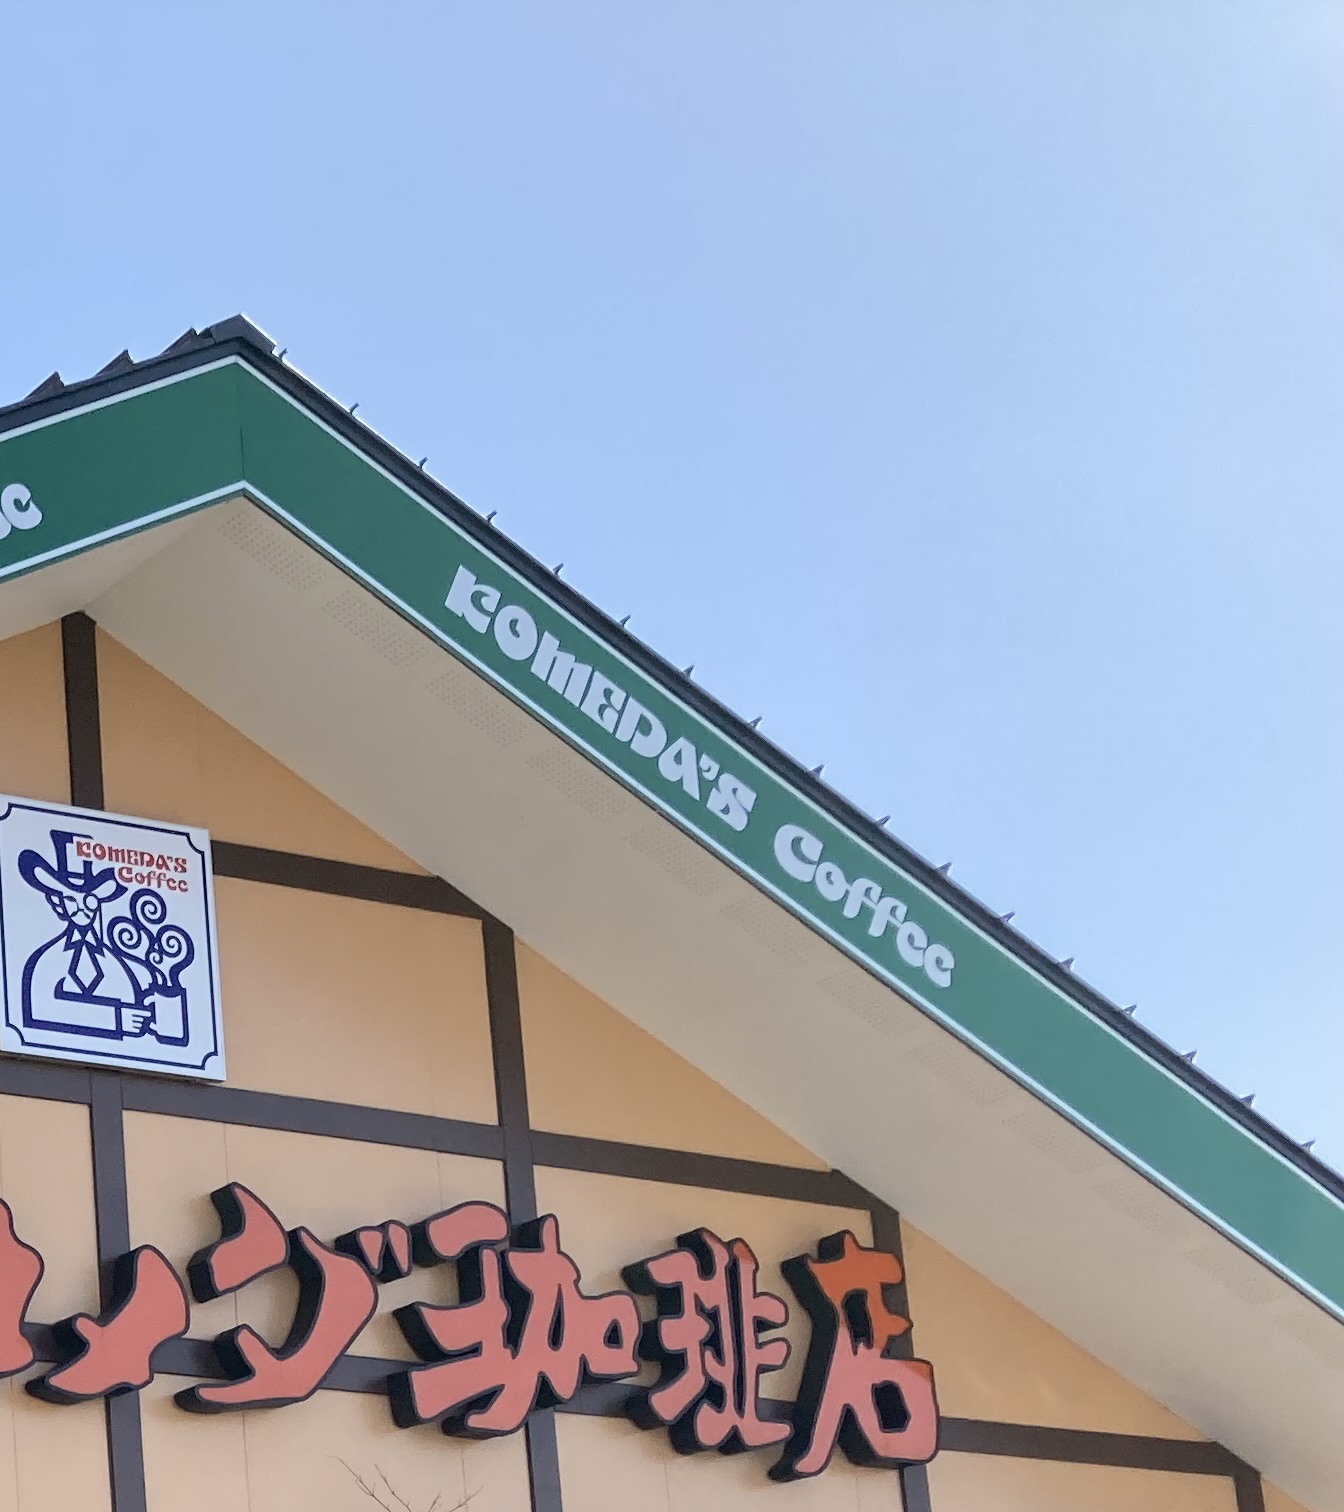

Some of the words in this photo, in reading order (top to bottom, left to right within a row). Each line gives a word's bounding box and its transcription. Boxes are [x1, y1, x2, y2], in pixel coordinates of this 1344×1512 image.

[444, 564, 757, 832] KOMEDA'S
[773, 823, 956, 989] Coffee
[75, 841, 188, 874] KOMEDA'S
[117, 866, 189, 893] Coffee
